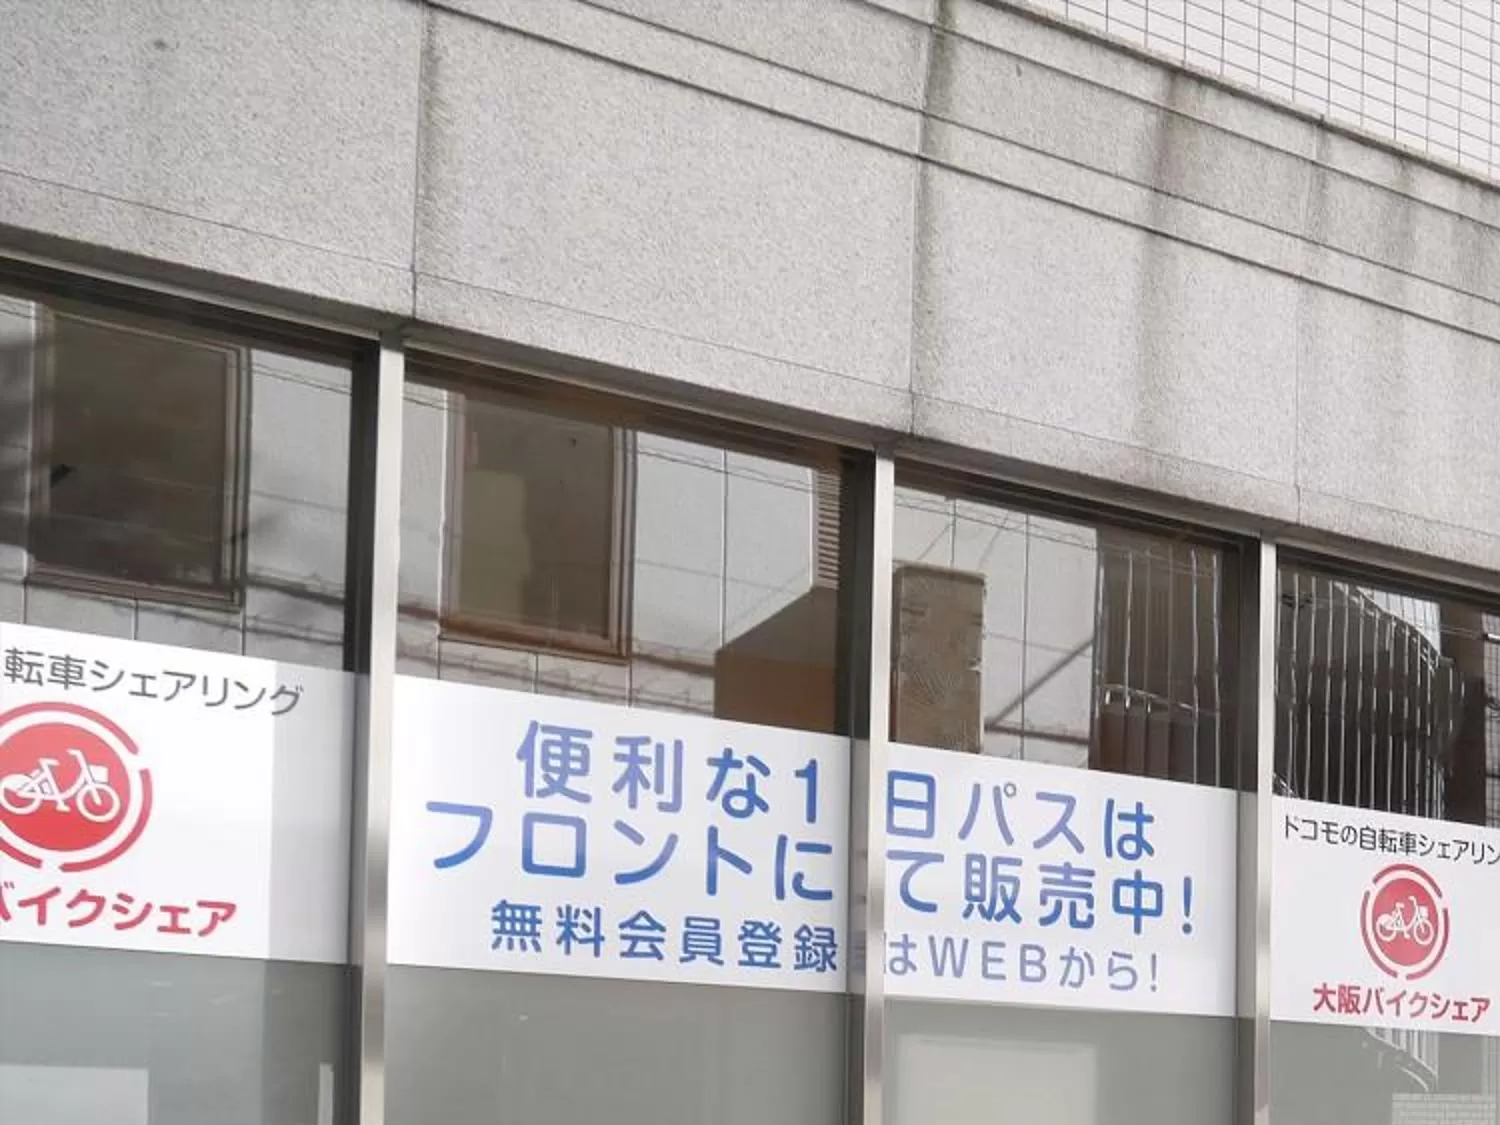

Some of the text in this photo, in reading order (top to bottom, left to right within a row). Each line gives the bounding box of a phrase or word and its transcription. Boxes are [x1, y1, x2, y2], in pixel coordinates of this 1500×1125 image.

[4, 646, 304, 716] 転車シェアリング
[425, 800, 834, 902] フロントに
[886, 770, 1156, 862] 日パスは
[490, 899, 838, 974] 無料会員登録
[1312, 982, 1492, 1023] 大阪バイクシェア
